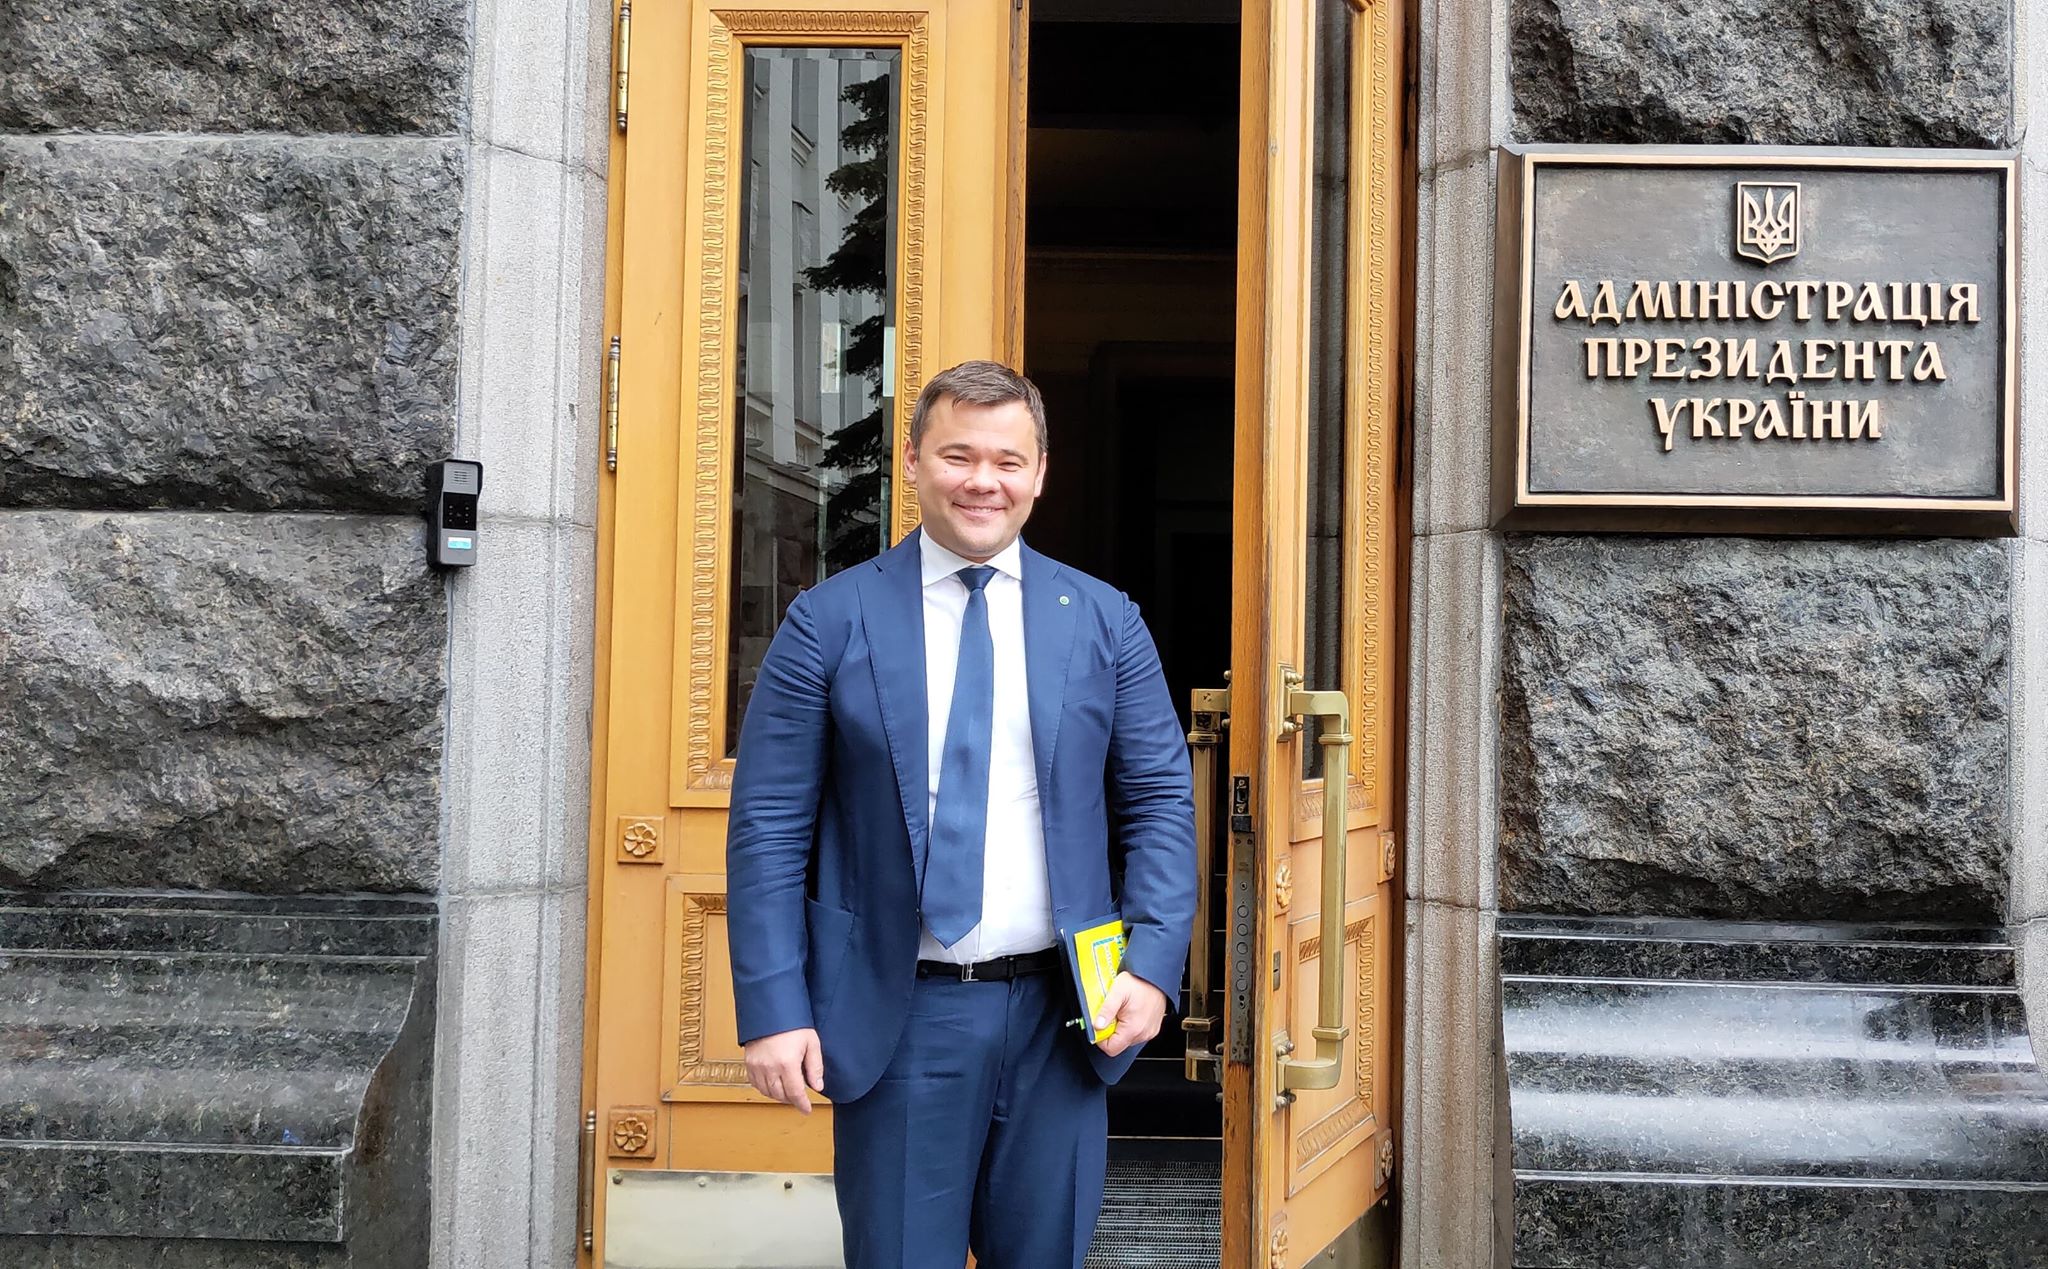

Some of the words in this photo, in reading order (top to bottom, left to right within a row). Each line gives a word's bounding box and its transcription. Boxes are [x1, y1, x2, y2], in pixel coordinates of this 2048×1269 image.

[1555, 280, 1980, 327] АДМІНІСТРАЦІЯ
[1585, 338, 1946, 384] ПРЕЗИДЕНТА
[1651, 391, 1882, 451] УКРАЇНИ
